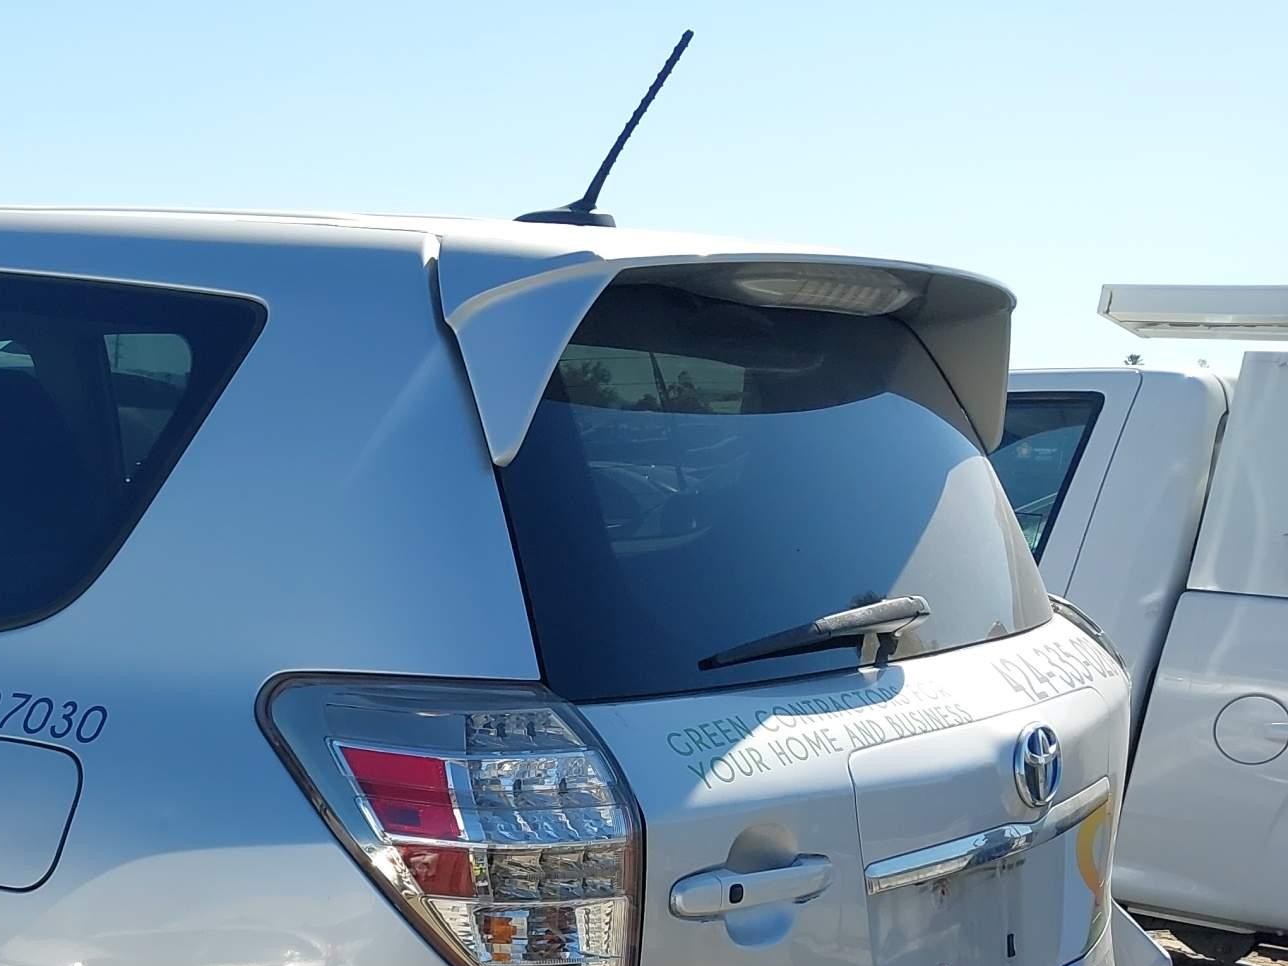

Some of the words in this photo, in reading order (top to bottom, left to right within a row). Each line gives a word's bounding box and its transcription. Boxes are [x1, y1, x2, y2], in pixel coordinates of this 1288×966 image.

[666, 715, 755, 757] GREEN
[754, 684, 910, 732] CONTRACTORS
[687, 746, 772, 790] YOUR
[767, 727, 842, 767] HOME
[846, 713, 887, 750] AND
[884, 702, 974, 740] BUSINESS
